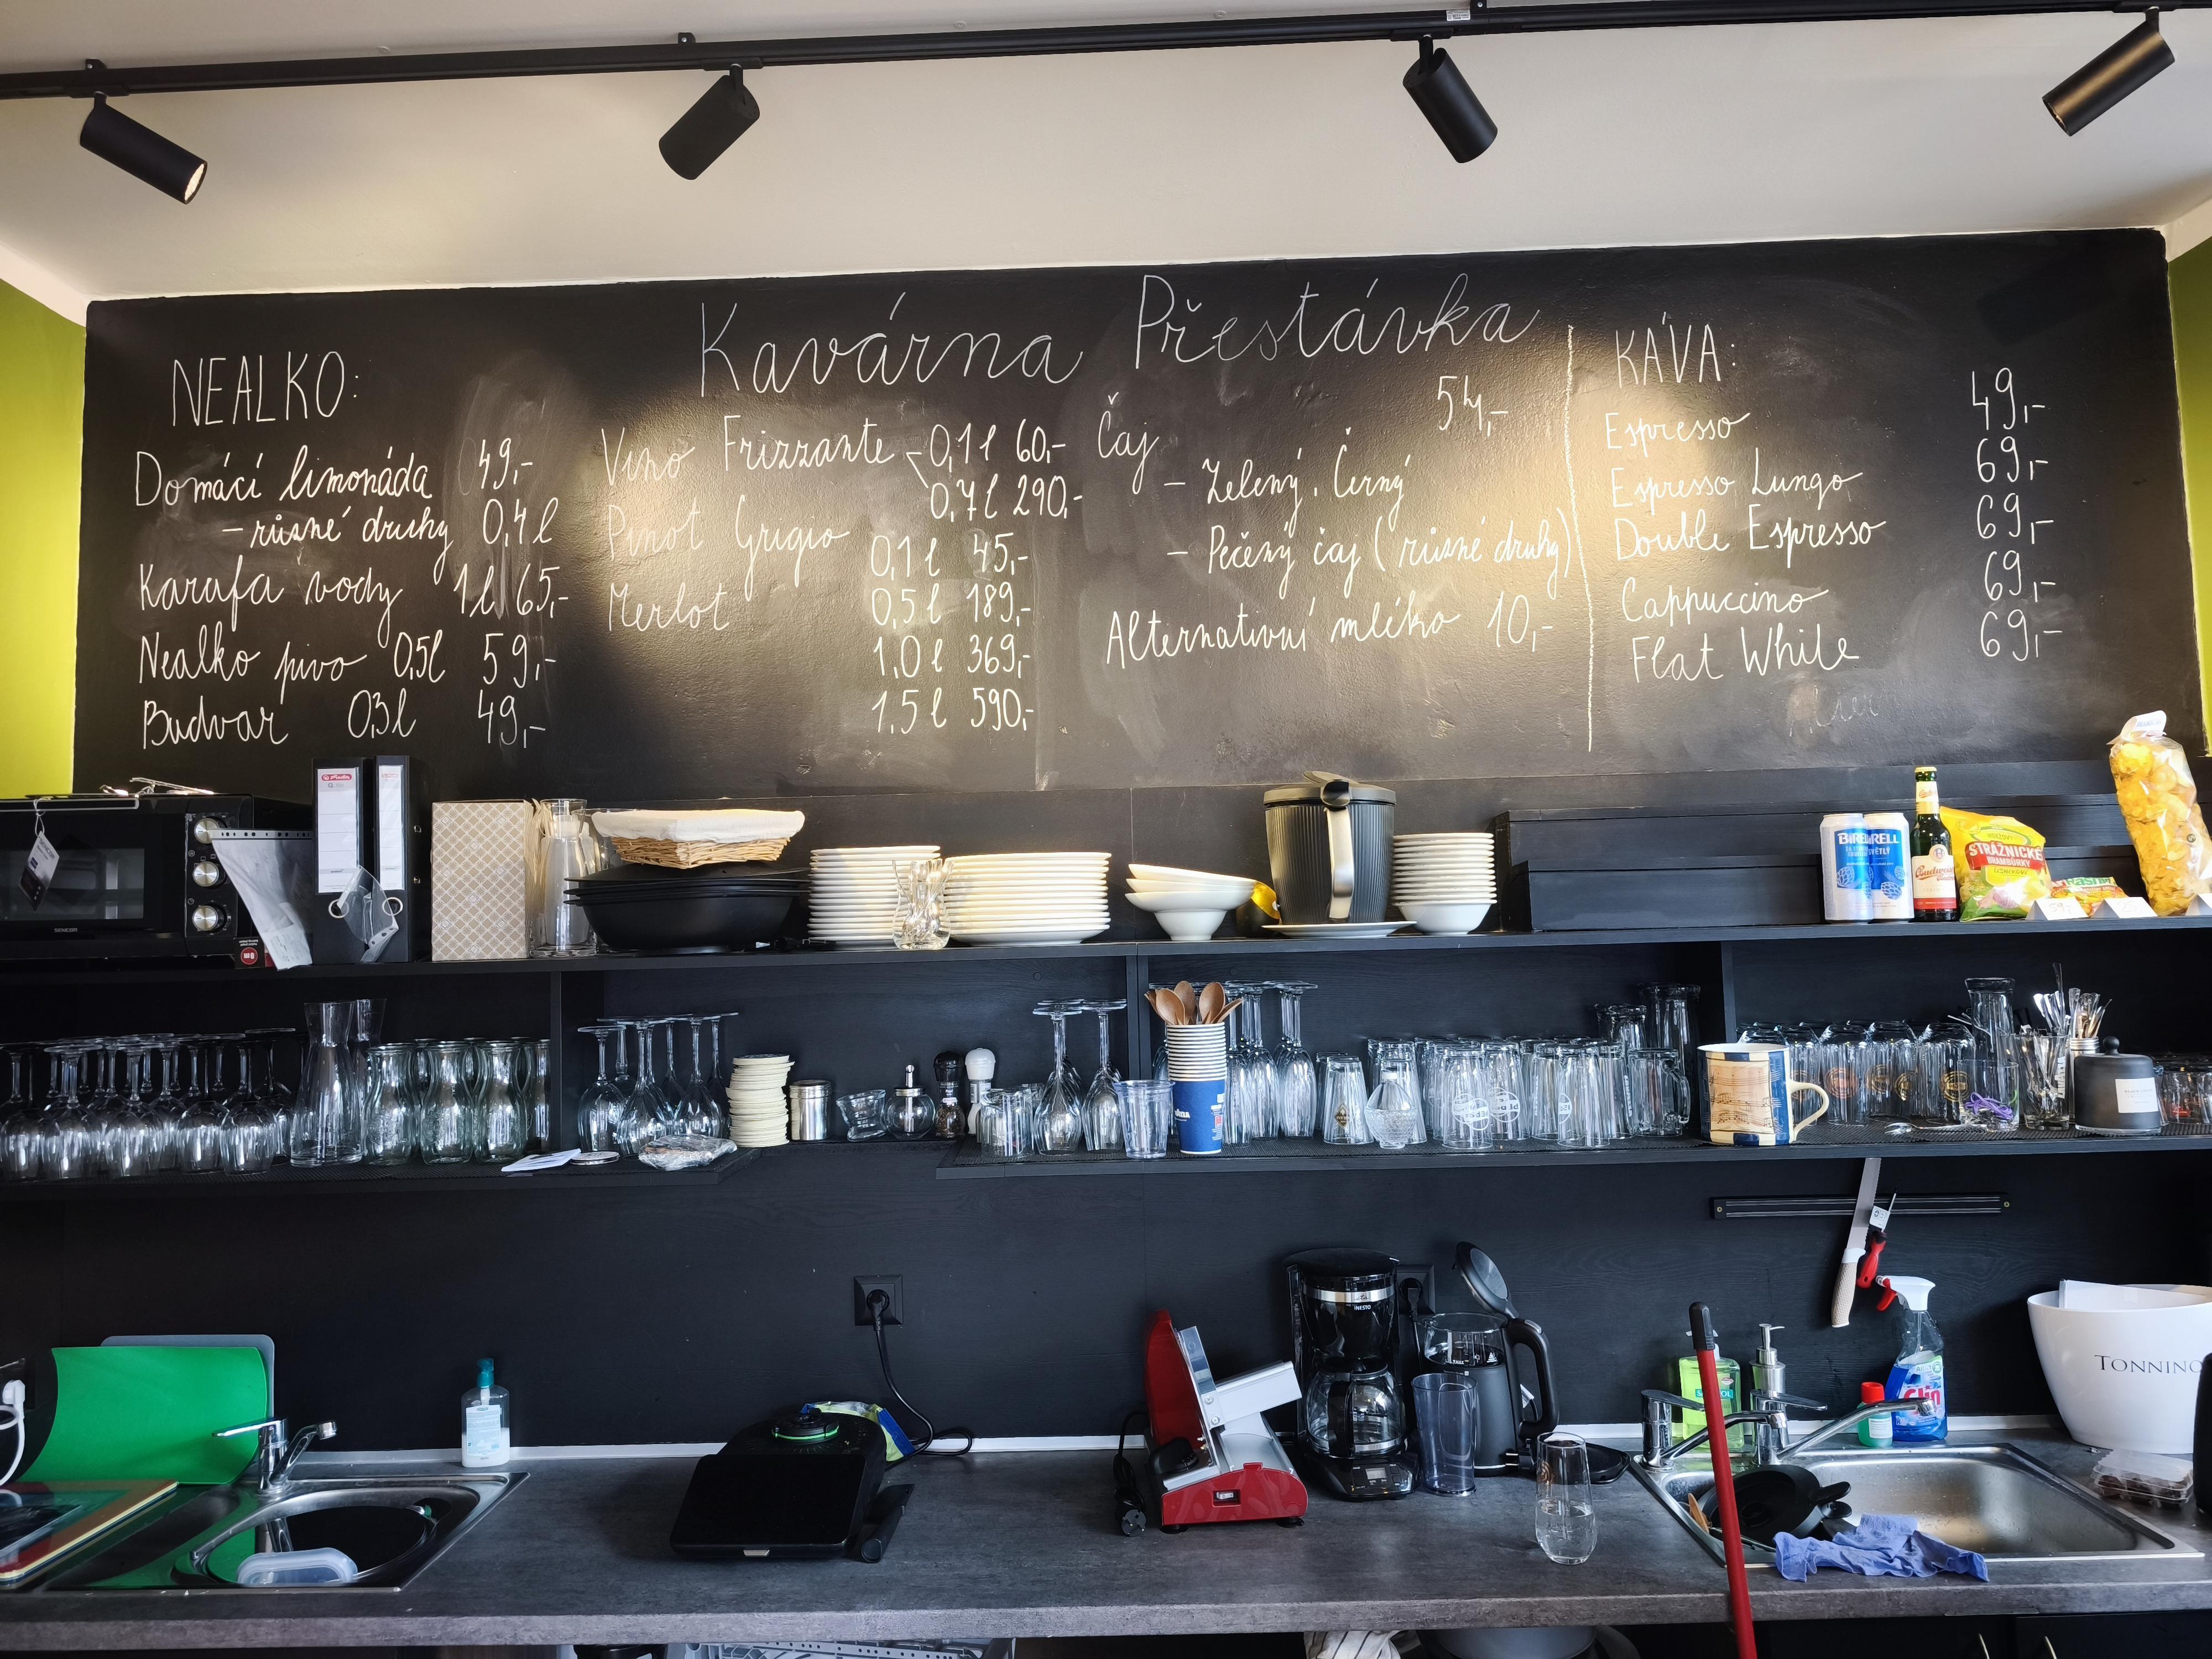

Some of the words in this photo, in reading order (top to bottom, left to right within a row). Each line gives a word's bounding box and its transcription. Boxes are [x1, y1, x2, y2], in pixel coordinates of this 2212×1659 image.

[701, 291, 1084, 398] Kavárna
[1134, 273, 1540, 370] Přestávka
[1615, 311, 1736, 389] KÁVA:
[173, 351, 358, 426] NEALKO:
[723, 415, 895, 472] Frizzante
[1098, 392, 1160, 495] Čaj
[1605, 411, 1751, 457] Espresso
[136, 451, 262, 507] Domácí
[279, 445, 432, 502] limonáda
[1333, 426, 1411, 532] Černý
[1611, 467, 1736, 509] Espresso
[1751, 447, 1864, 510] Lungo
[363, 505, 453, 585] druhy
[608, 497, 703, 561] Pinot
[734, 494, 851, 602] Grigio
[1208, 521, 1296, 600] Pečený
[1313, 526, 1363, 598] čaj
[1614, 508, 1730, 562] Double
[1747, 502, 1887, 568] Espresso
[140, 555, 284, 632] Karafa
[305, 567, 403, 648] vody
[608, 582, 731, 632] Merlot
[1106, 596, 1316, 670] Alternativní
[1329, 589, 1463, 644] mléko
[1621, 576, 1829, 627] Cappuccino
[139, 621, 261, 684] Nealko
[274, 641, 368, 705] pivo
[1631, 634, 1724, 684] Flat
[1741, 622, 1860, 677] White
[143, 695, 288, 750] Budvar
[1969, 841, 2043, 861] STRÁŽNICKÉ
[1987, 856, 2031, 868] BRAMBŮRKY
[2094, 1355, 2203, 1374] TONNINO
